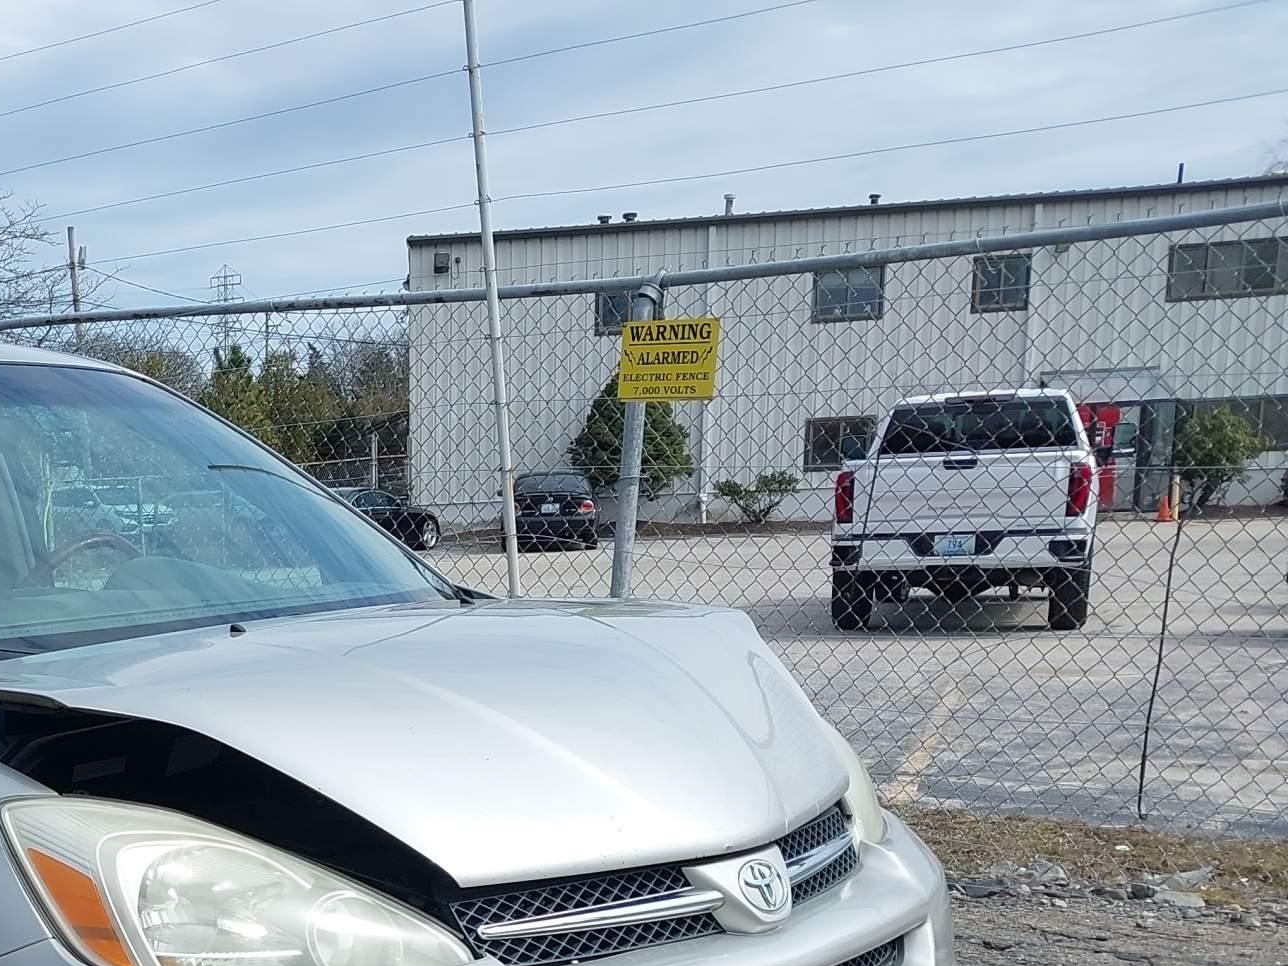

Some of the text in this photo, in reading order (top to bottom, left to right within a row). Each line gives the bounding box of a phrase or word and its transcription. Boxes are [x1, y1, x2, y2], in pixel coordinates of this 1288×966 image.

[630, 323, 712, 342] WARNING
[637, 351, 699, 365] ALARMED
[623, 372, 709, 382] ELECTRIC FENCE
[633, 386, 696, 395] 7,000 VOLTS
